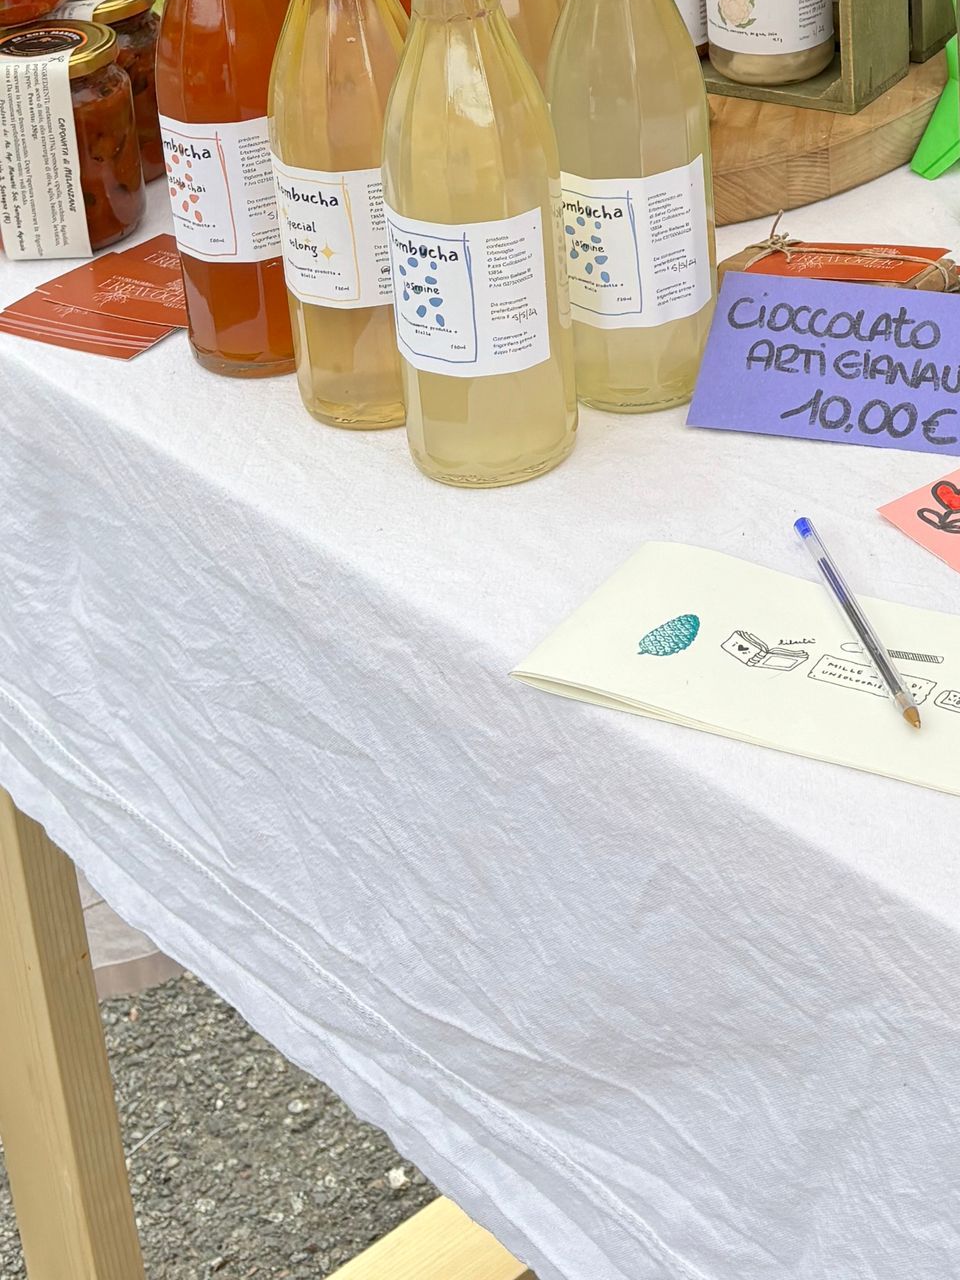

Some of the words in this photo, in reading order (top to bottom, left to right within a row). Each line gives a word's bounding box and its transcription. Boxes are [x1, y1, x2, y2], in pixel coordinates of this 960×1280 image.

[57, 118, 69, 156] CAPONATA
[63, 167, 77, 213] MELANZANE
[188, 183, 206, 193] chai
[287, 217, 316, 233] pecial
[780, 389, 958, 445] 10,00€
